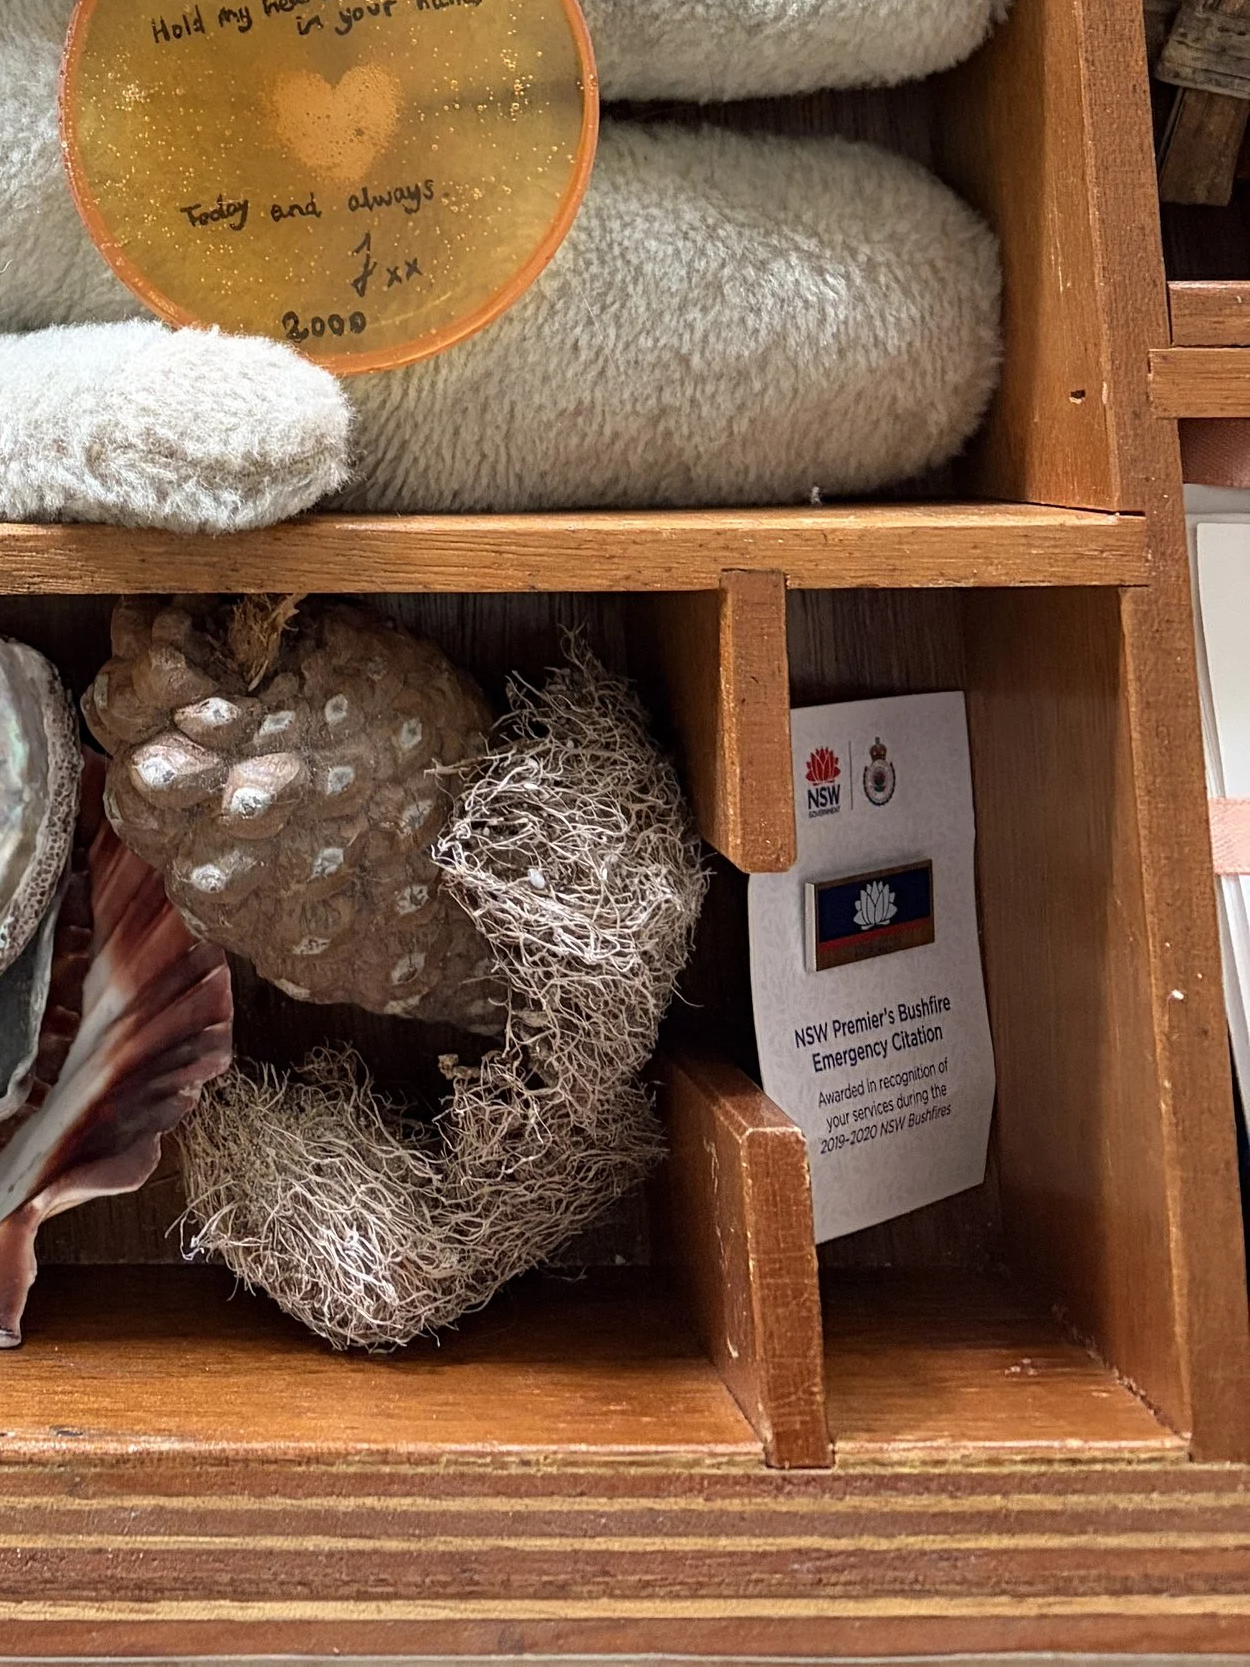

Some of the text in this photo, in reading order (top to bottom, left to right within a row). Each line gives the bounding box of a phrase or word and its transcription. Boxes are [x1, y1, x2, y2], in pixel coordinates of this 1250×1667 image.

[151, 5, 206, 44] Hold
[218, 5, 253, 33] my
[297, 16, 323, 35] in
[334, 0, 398, 35] your
[180, 194, 249, 231] Today
[270, 192, 323, 222] and
[282, 310, 367, 344] 2000
[807, 784, 840, 809] NSW
[794, 995, 951, 1049] NSW Premier's Bushfire
[812, 1025, 943, 1073] Emergency Citation
[818, 1056, 949, 1108] Awarded in recognition of
[820, 1103, 952, 1155] 2019-2020 NSW Bushfires
[826, 1083, 948, 1134] your services during the
